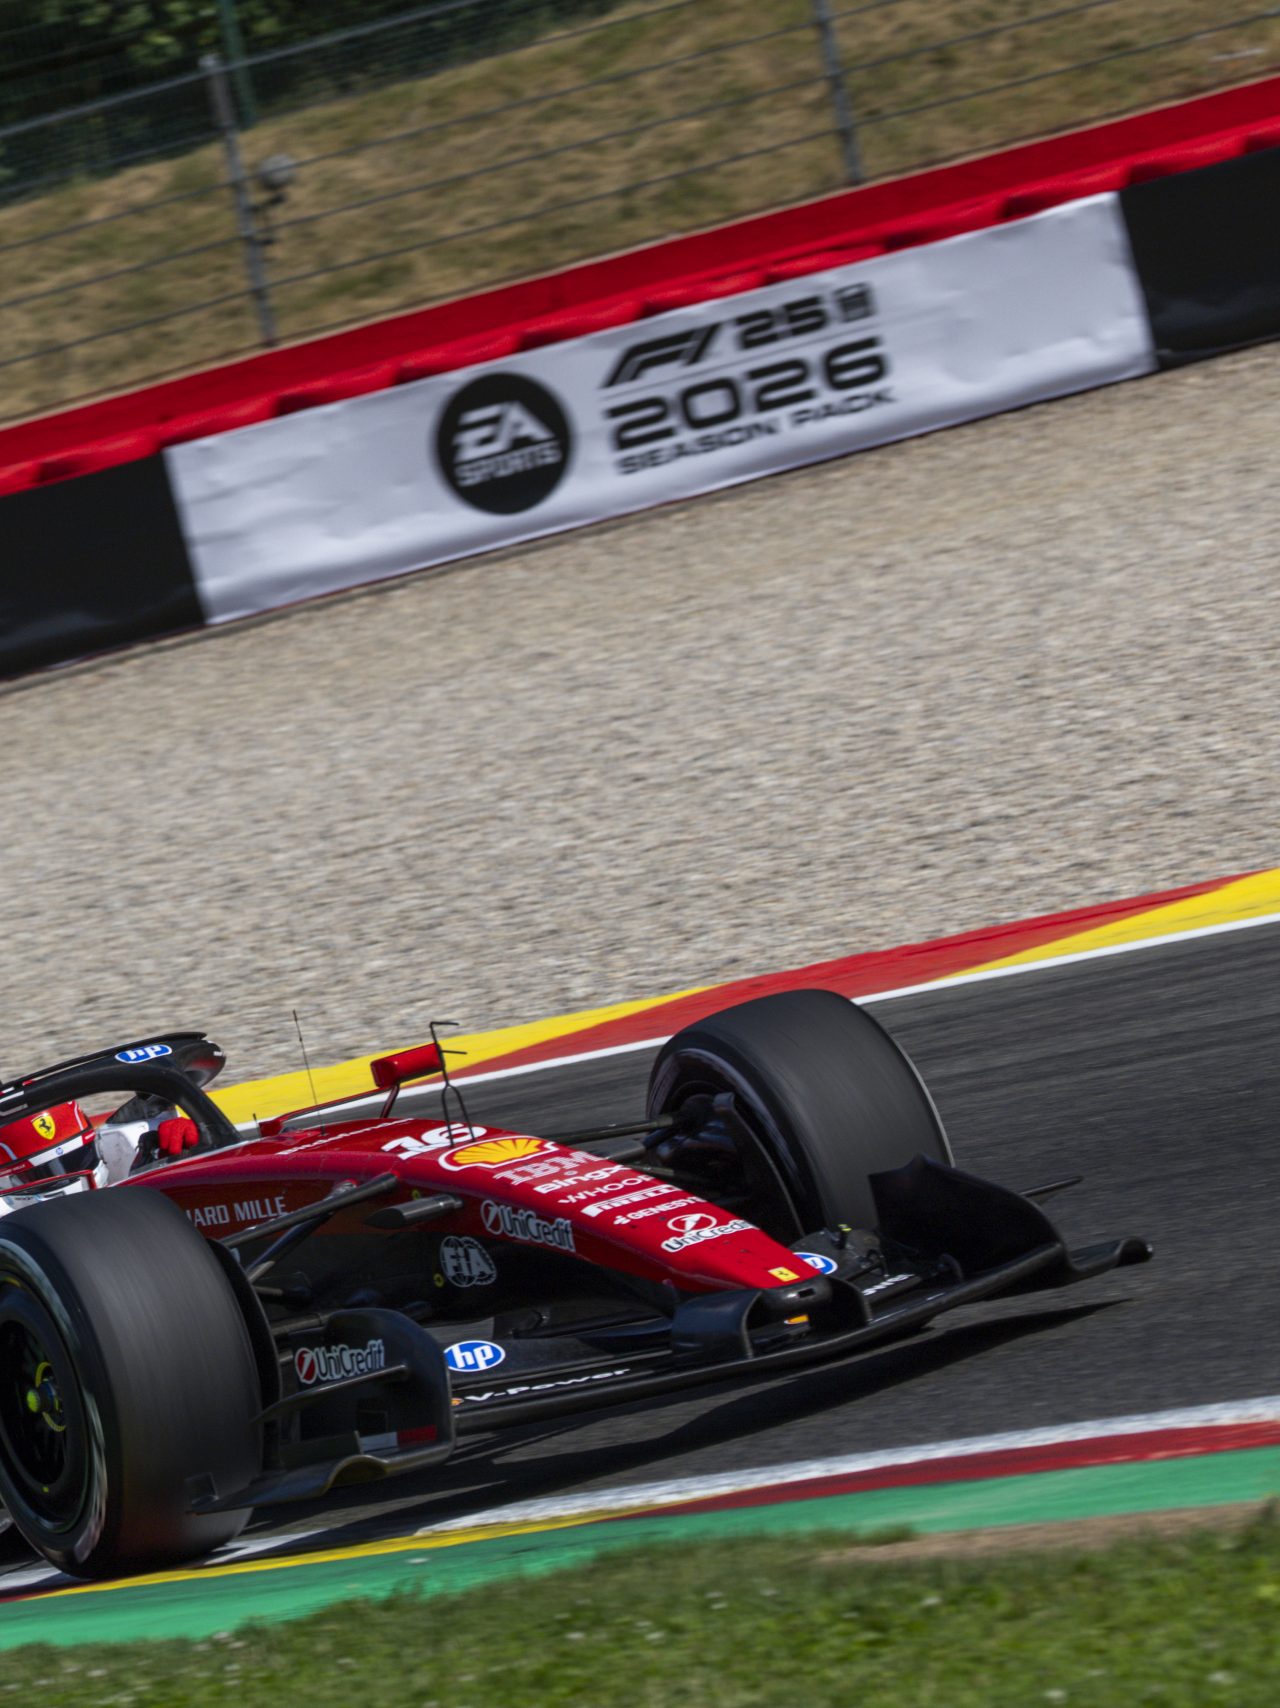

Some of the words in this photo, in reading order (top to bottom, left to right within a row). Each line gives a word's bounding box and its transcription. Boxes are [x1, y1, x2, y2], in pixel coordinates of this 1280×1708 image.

[735, 296, 828, 350] 25
[604, 336, 886, 450] 2026
[453, 400, 556, 462] EA
[616, 417, 782, 475] SEASON
[790, 387, 902, 429] PACK
[453, 441, 562, 488] SPORTS
[129, 1044, 163, 1062] hp
[381, 1122, 488, 1160] 16
[492, 1150, 604, 1186] IBM
[186, 1203, 230, 1227] ARD
[233, 1196, 288, 1222] MILLE
[498, 1204, 576, 1253] UniCredit
[442, 1246, 496, 1277] FIA
[315, 1338, 386, 1380] UniCredit
[452, 1342, 495, 1370] hp
[464, 1368, 631, 1402] V-Power
